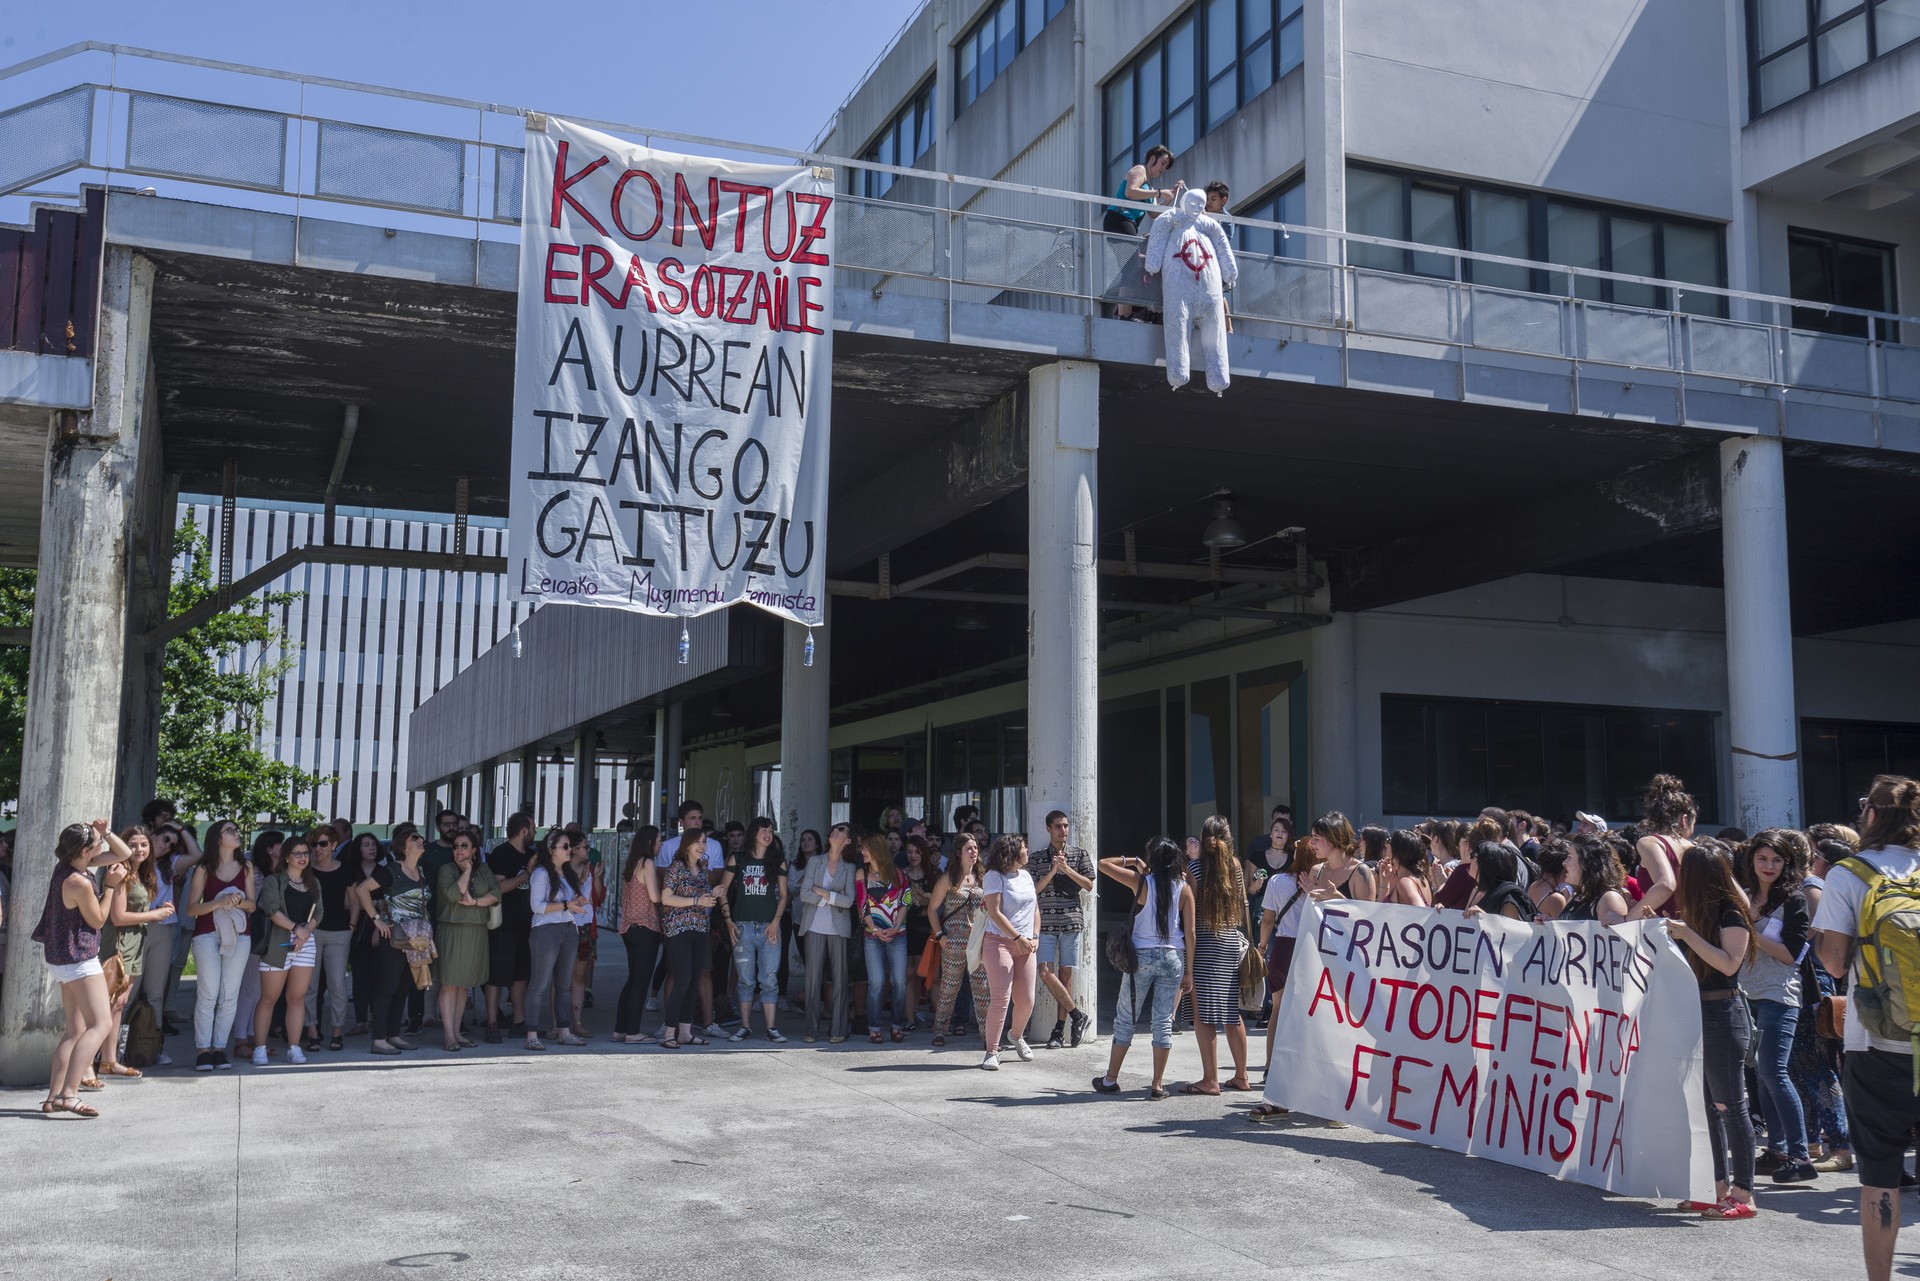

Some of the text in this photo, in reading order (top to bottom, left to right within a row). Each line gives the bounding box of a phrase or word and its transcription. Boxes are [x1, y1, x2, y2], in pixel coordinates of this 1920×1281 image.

[550, 140, 834, 266] KONTUZ
[548, 317, 805, 419] AURREAN
[527, 409, 770, 505] IZANGO
[536, 490, 814, 578] GAITUZU
[629, 570, 725, 613] Mugimendu
[745, 575, 816, 611] Feminista
[1318, 909, 1506, 978] ERASOEN
[1308, 967, 1641, 1077] AUTODEFENTSA
